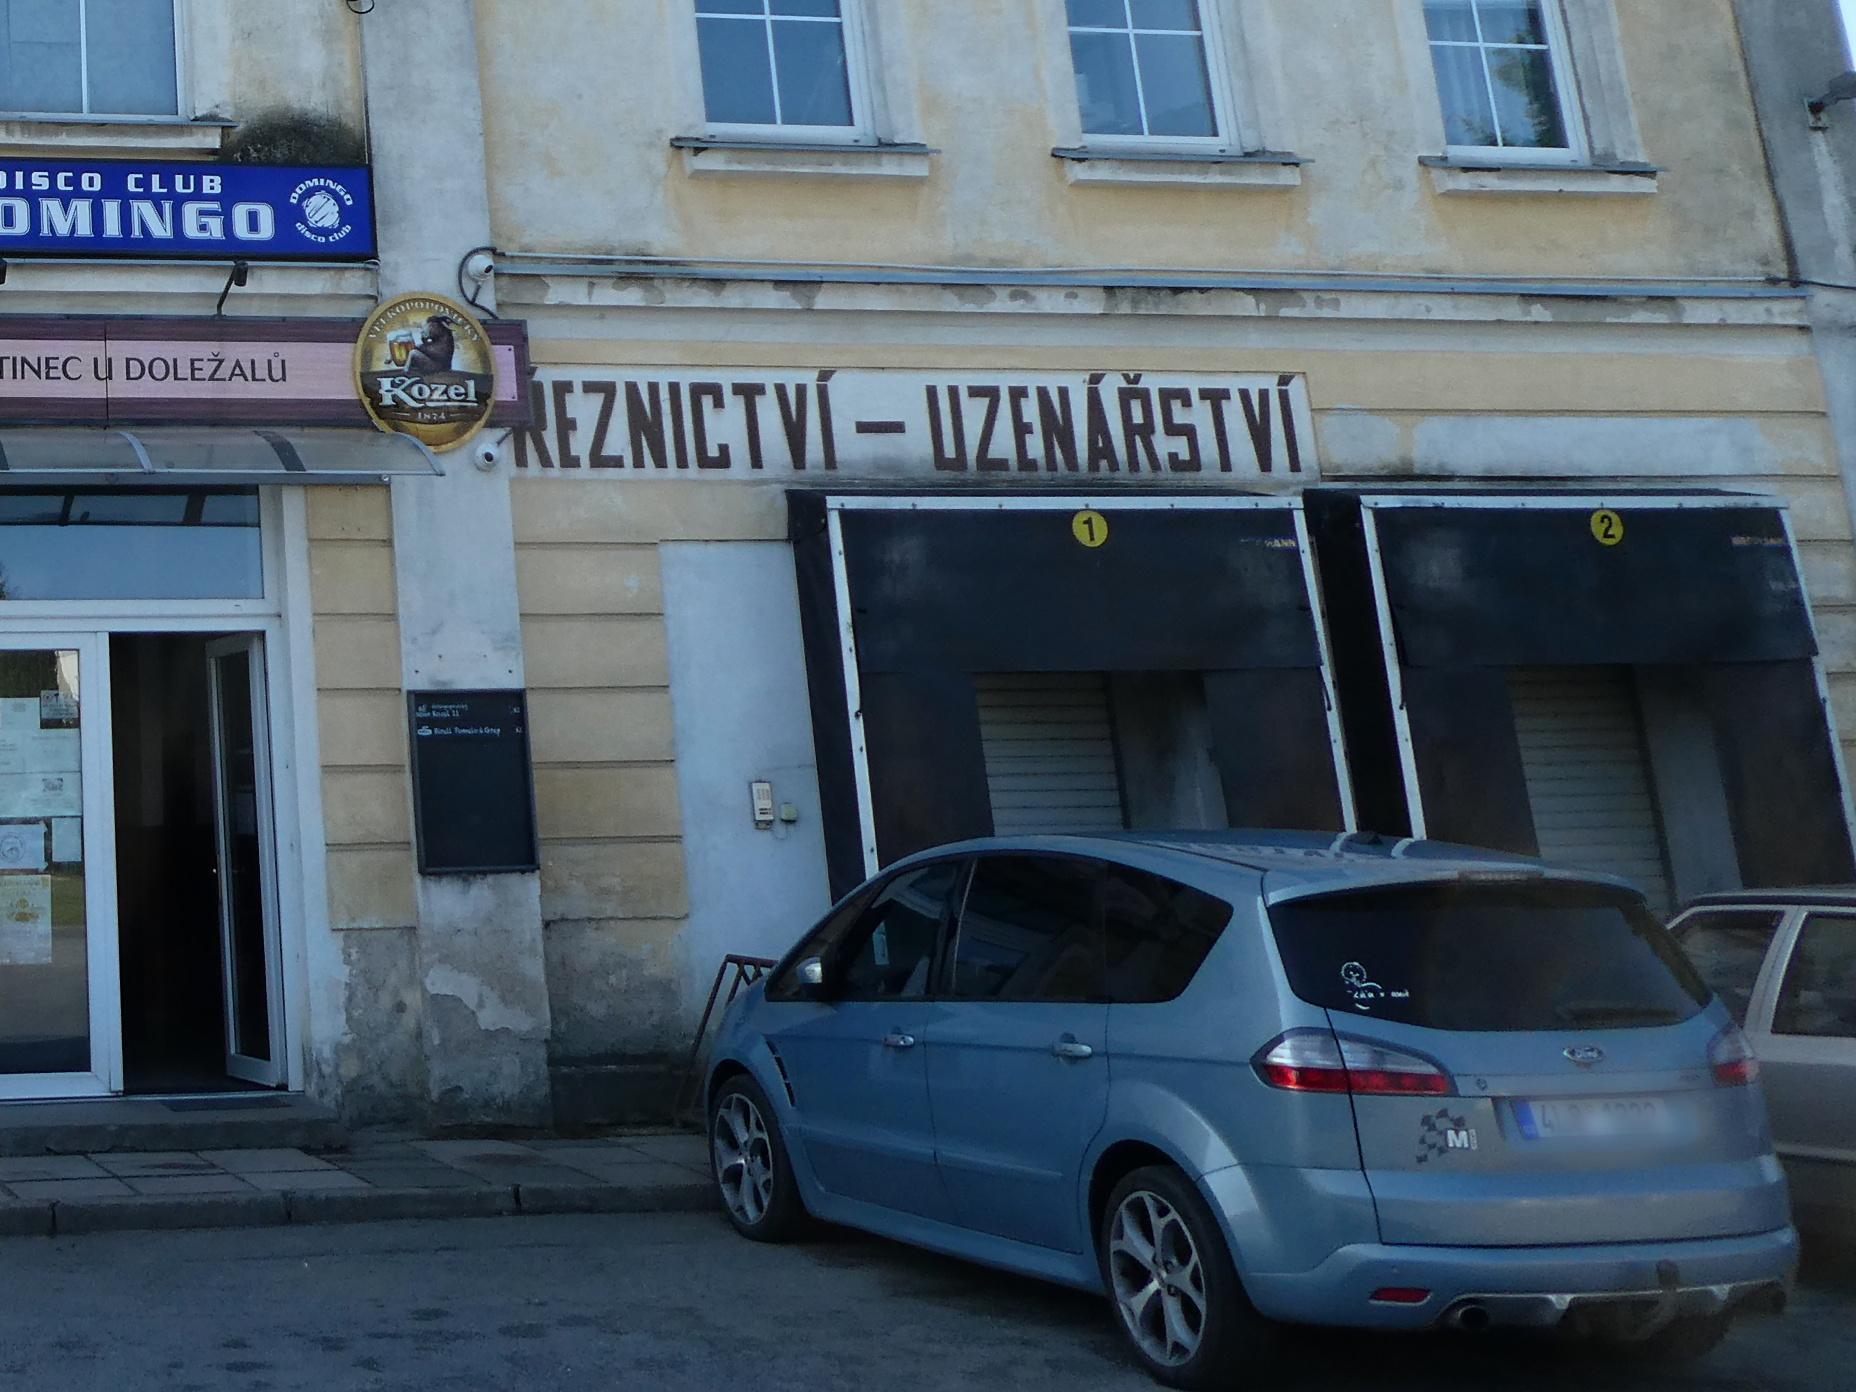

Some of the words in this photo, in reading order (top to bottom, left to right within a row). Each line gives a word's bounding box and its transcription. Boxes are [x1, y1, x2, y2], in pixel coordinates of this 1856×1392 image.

[127, 173, 222, 194] CLUB
[289, 177, 353, 206] DOMINGO
[295, 221, 326, 243] disco
[328, 223, 352, 242] club
[94, 357, 113, 381] U
[125, 352, 287, 383] DOLEŽALŮ
[377, 375, 479, 408] Kozel
[417, 412, 446, 420] 1874
[925, 373, 1302, 473] UZENÁŘSTVÍ
[1082, 516, 1096, 542] 1
[1600, 514, 1616, 539] 2
